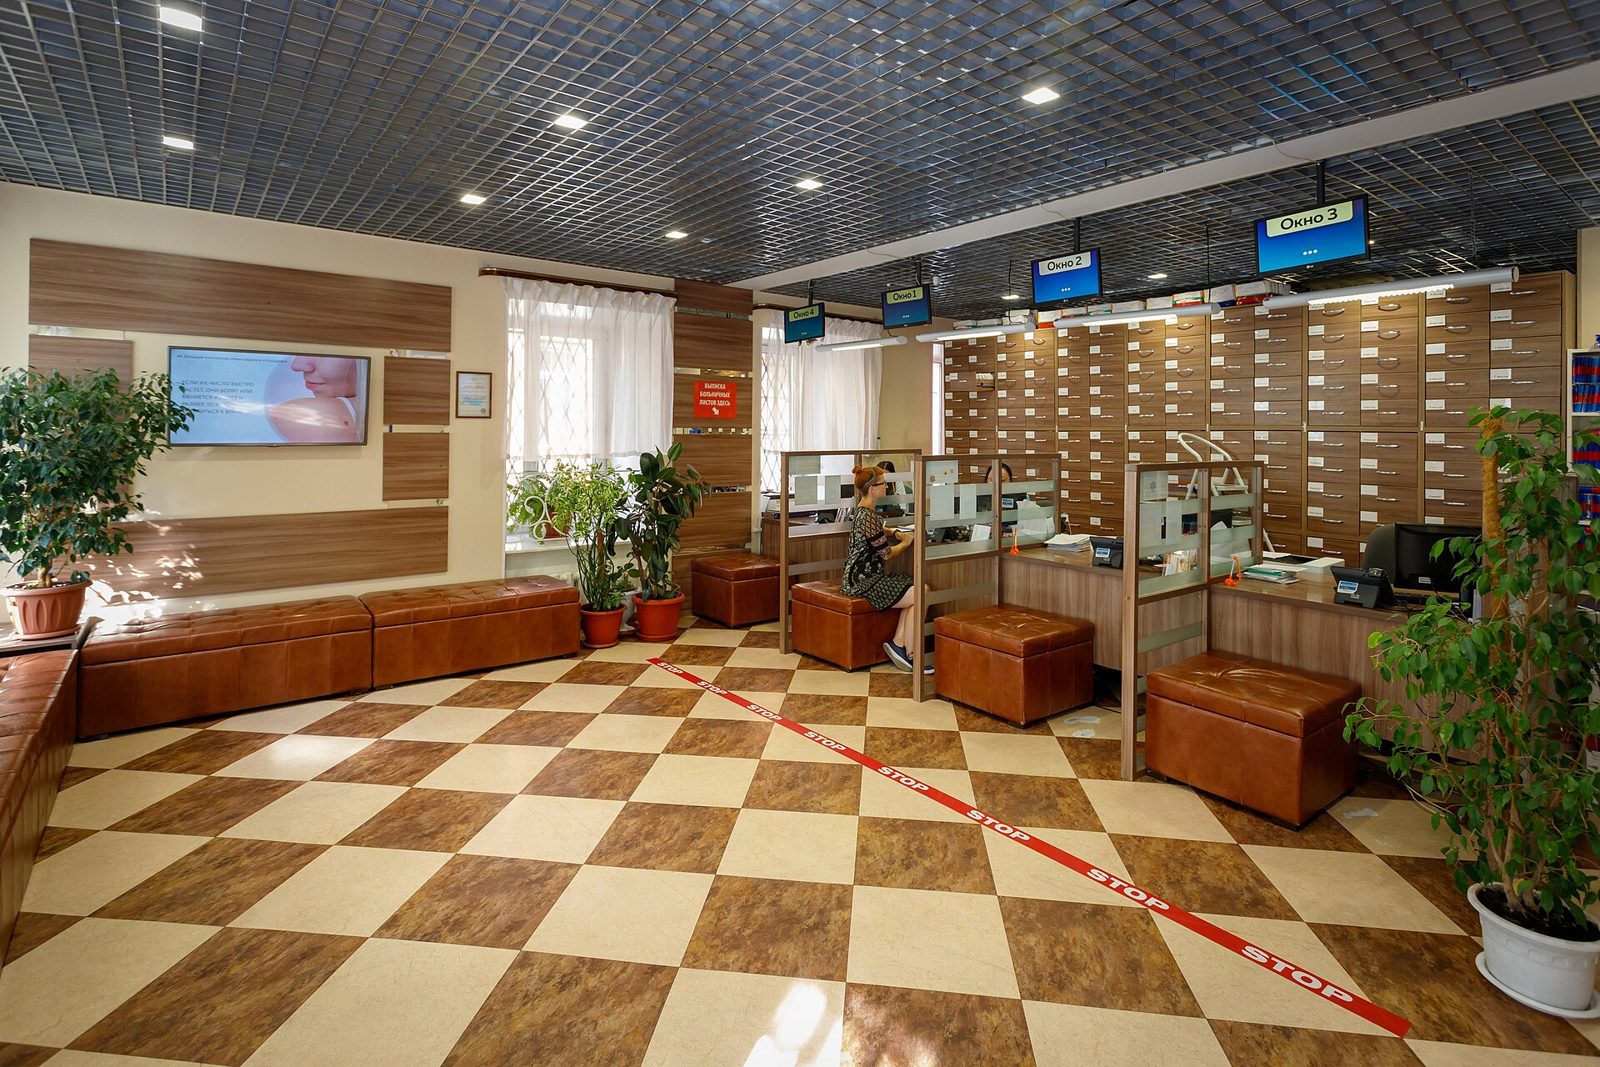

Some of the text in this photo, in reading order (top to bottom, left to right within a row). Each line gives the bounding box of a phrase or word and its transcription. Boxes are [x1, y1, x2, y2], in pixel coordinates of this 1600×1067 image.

[1280, 208, 1338, 231] Окно 3
[1047, 256, 1083, 271] Окно 2
[893, 290, 917, 301] Окно 1
[793, 309, 809, 319] Окно
[656, 662, 1354, 1003] STOP STOP STOP STOP STOP STOP STOP STOP
